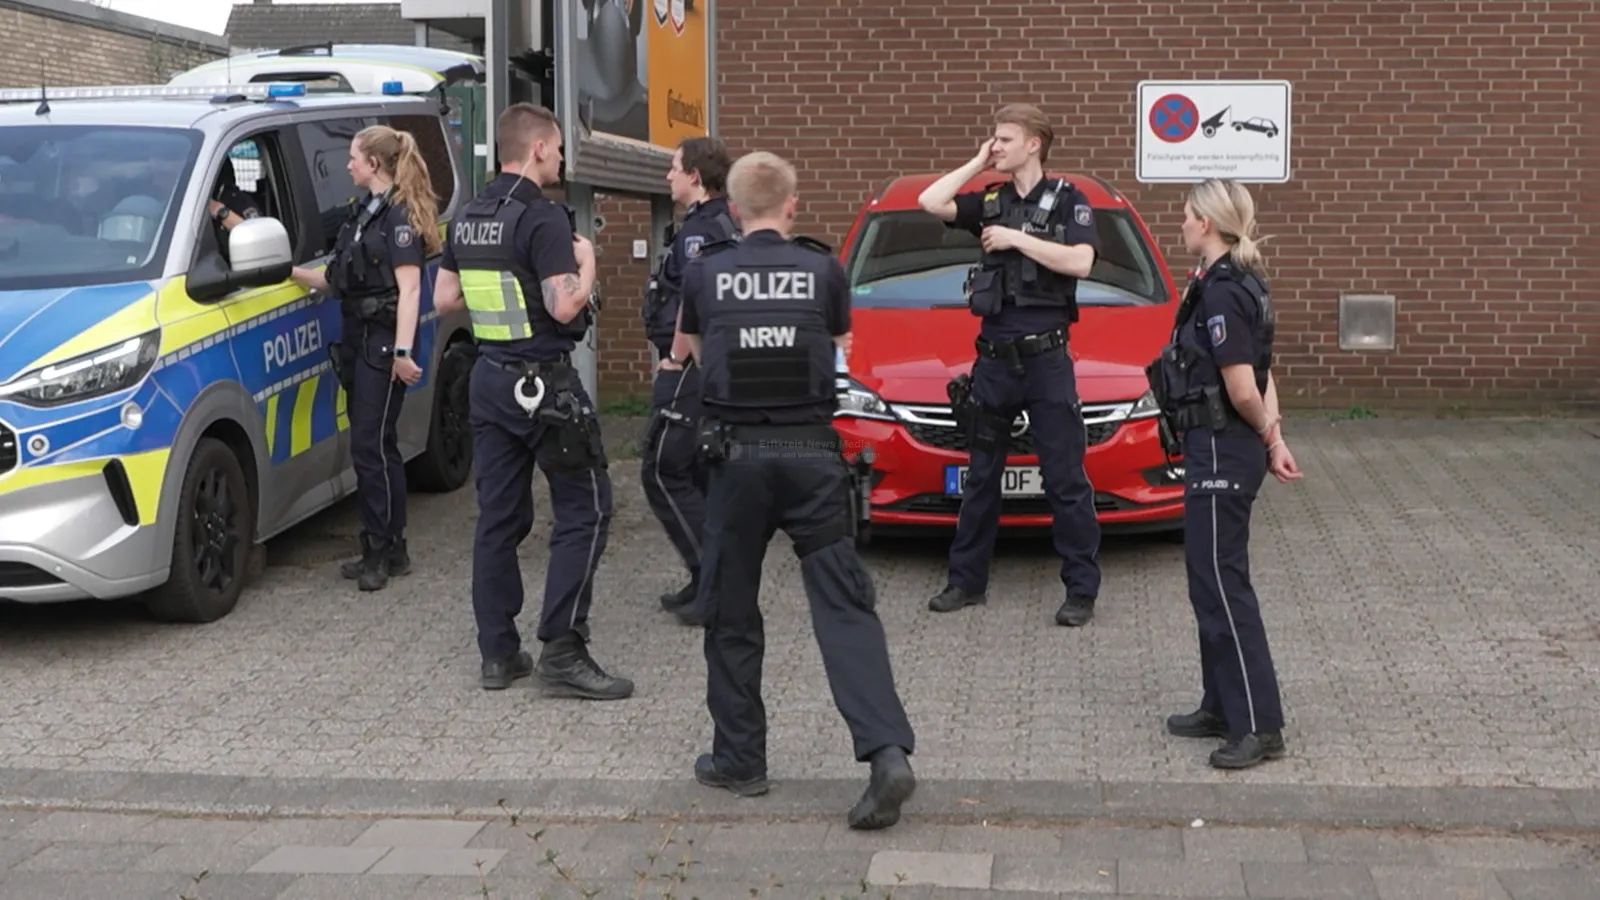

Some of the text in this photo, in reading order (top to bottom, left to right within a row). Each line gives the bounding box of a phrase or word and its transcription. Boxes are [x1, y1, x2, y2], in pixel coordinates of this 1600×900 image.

[454, 221, 504, 246] POLIZEI
[716, 271, 815, 300] POLIZEI
[263, 318, 322, 374] POLIZEI
[739, 326, 797, 348] NRW
[1004, 469, 1032, 491] DF
